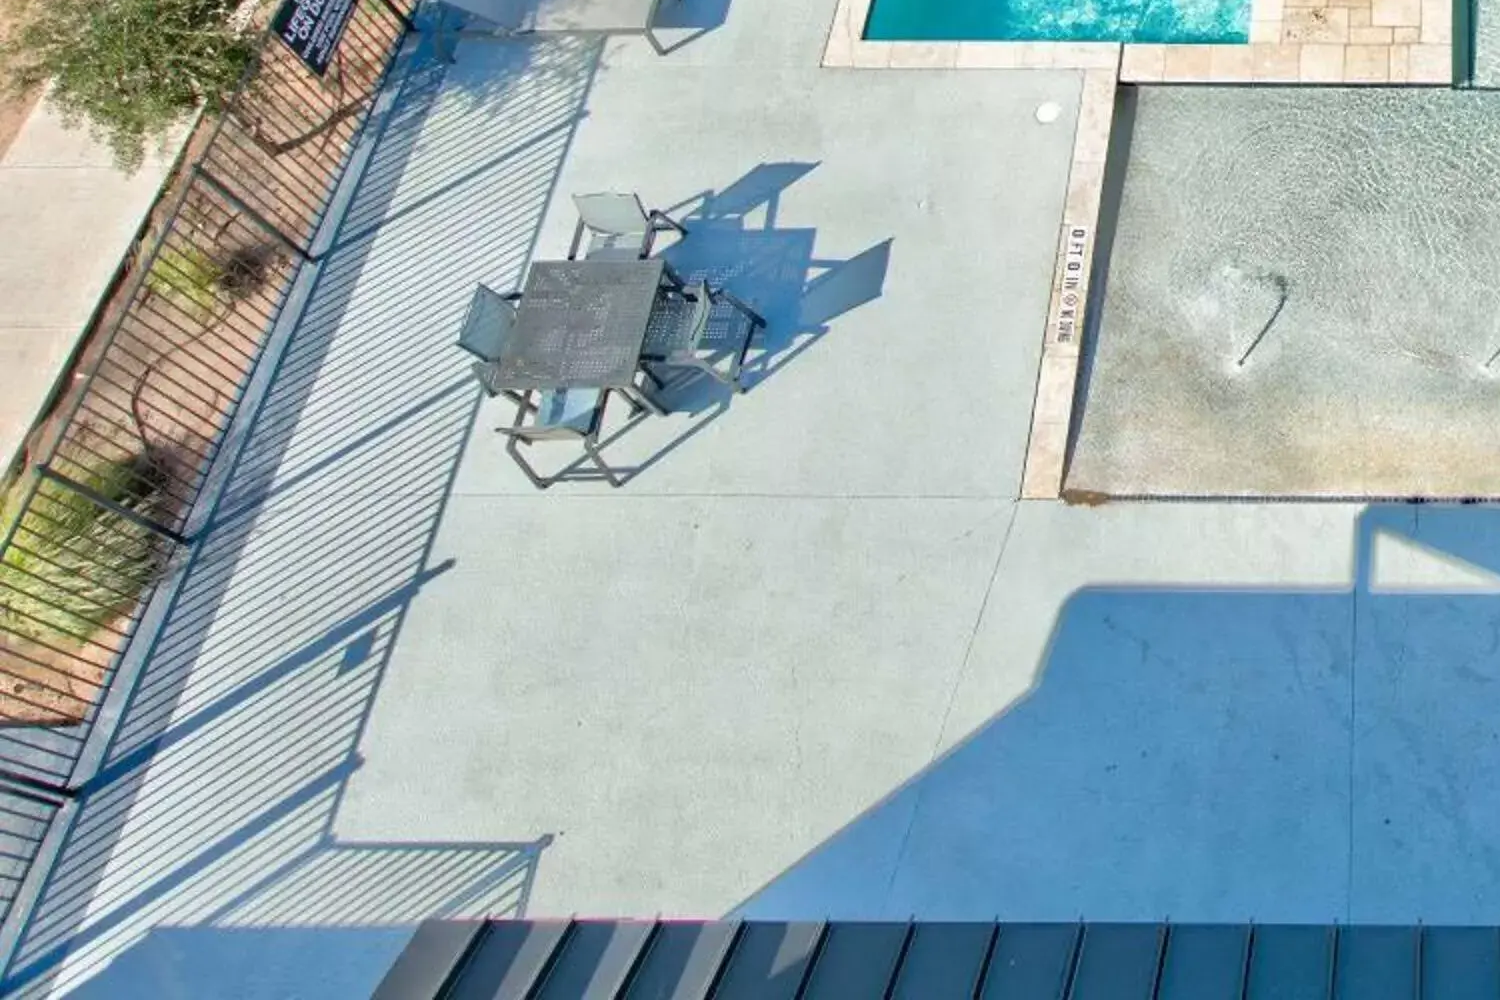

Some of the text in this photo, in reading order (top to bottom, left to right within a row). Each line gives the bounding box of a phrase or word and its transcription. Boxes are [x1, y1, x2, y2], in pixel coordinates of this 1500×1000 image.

[297, 15, 315, 41] ON
[1072, 229, 1086, 238] 0
[1069, 242, 1084, 257] FT
[1067, 262, 1081, 271] 0
[1064, 277, 1079, 289] IN
